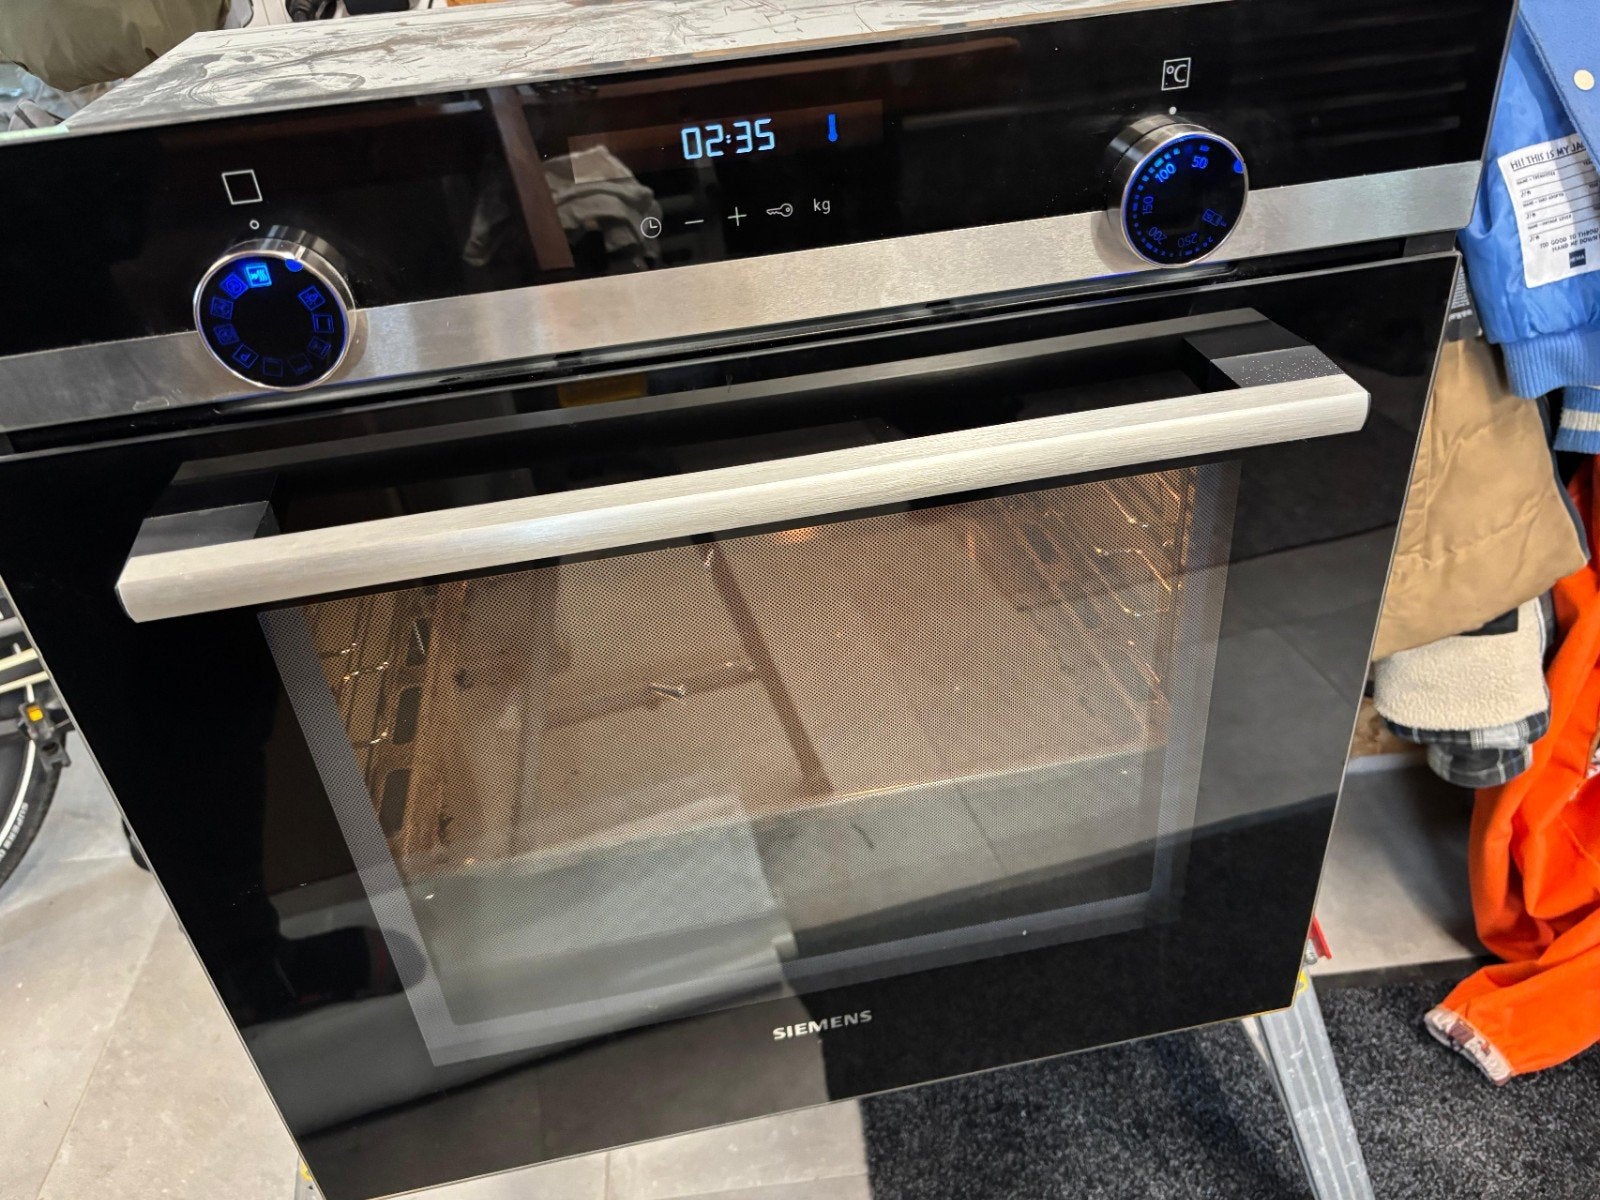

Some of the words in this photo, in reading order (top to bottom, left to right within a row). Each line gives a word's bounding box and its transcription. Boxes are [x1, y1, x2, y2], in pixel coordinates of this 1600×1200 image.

[681, 118, 776, 160] 02:35
[1191, 155, 1209, 169] 50
[1510, 157, 1526, 170] HI!
[1526, 152, 1544, 165] THIS
[1546, 149, 1555, 160] IS
[1556, 144, 1570, 156] MY
[1155, 163, 1176, 183] 100
[813, 198, 831, 215] kg
[1142, 196, 1154, 215] 150
[1551, 236, 1567, 245] GOOD
[1569, 233, 1577, 241] TO
[1579, 235, 1598, 244] DOWN
[772, 1009, 873, 1040] SIEMENS
